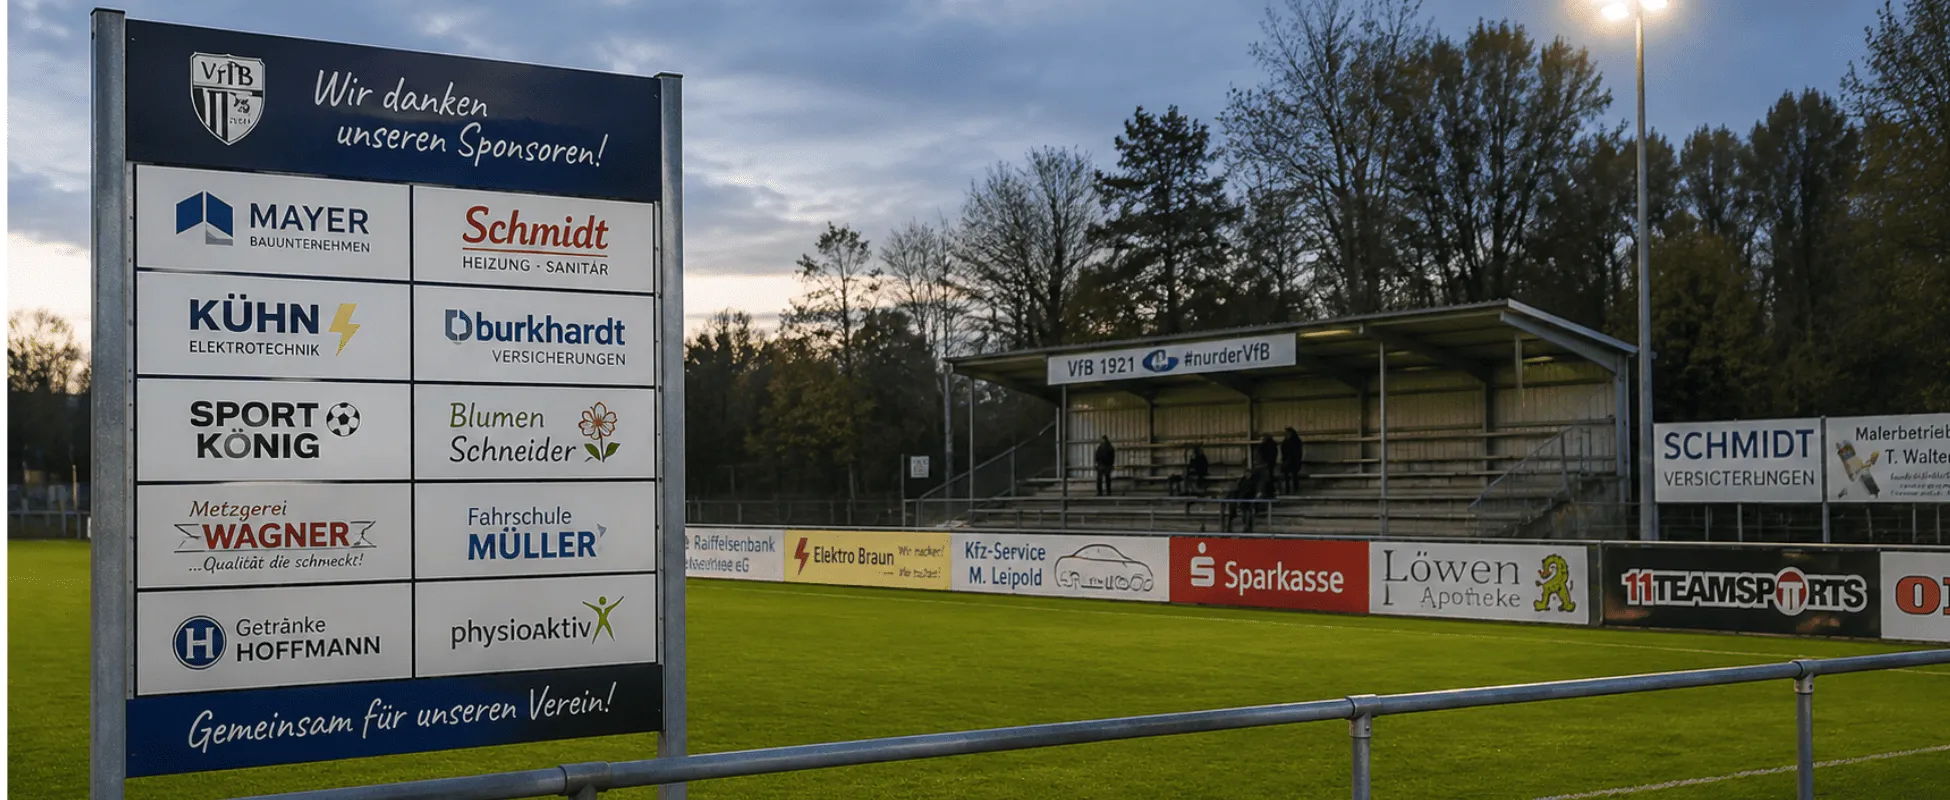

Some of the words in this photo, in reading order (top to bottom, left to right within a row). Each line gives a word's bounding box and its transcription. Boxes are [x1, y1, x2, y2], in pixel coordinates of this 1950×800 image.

[314, 69, 373, 107] Wir
[382, 77, 488, 117] danken
[336, 125, 447, 152] unseren
[457, 122, 608, 167] Sponsoren!
[249, 202, 370, 234] MAYER
[462, 205, 609, 250] Schmidt
[249, 236, 371, 253] BAUUNTERNEHMEN
[462, 256, 531, 272] HEIZUNG
[189, 293, 320, 335] KÜHN
[475, 311, 626, 346] burkhardt
[189, 340, 321, 357] ELEKTROTECHNIK
[491, 349, 627, 366] VERSICHERUNGEN
[1067, 359, 1095, 377] VfB
[1101, 356, 1135, 374] 1921
[1184, 342, 1271, 368] #nurderVfB
[190, 400, 319, 428] SPORT
[449, 402, 545, 428] Blumen
[197, 428, 320, 459] KÖNIG
[449, 435, 577, 463] Schneider
[1663, 429, 1815, 460] SCHMIDT
[1884, 447, 1899, 464] T.
[189, 500, 287, 521] Metzgerei
[467, 506, 572, 526] Fahrschule
[202, 521, 350, 550] WAGNER
[467, 526, 597, 561] MÜLLER
[269, 553, 290, 570] die
[813, 545, 855, 565] Elektro
[858, 547, 895, 566] Braun
[964, 541, 1046, 563] Kfz-Service
[968, 566, 987, 585] M.
[991, 566, 1043, 590] Leipold
[1224, 560, 1345, 597] Sparkasse
[1382, 550, 1521, 585] Löwen
[236, 635, 381, 662] HOFFMANN
[188, 709, 354, 754] Gemeinsam
[361, 697, 408, 740] für
[416, 702, 517, 728] unseren
[529, 681, 617, 721] Verein!
